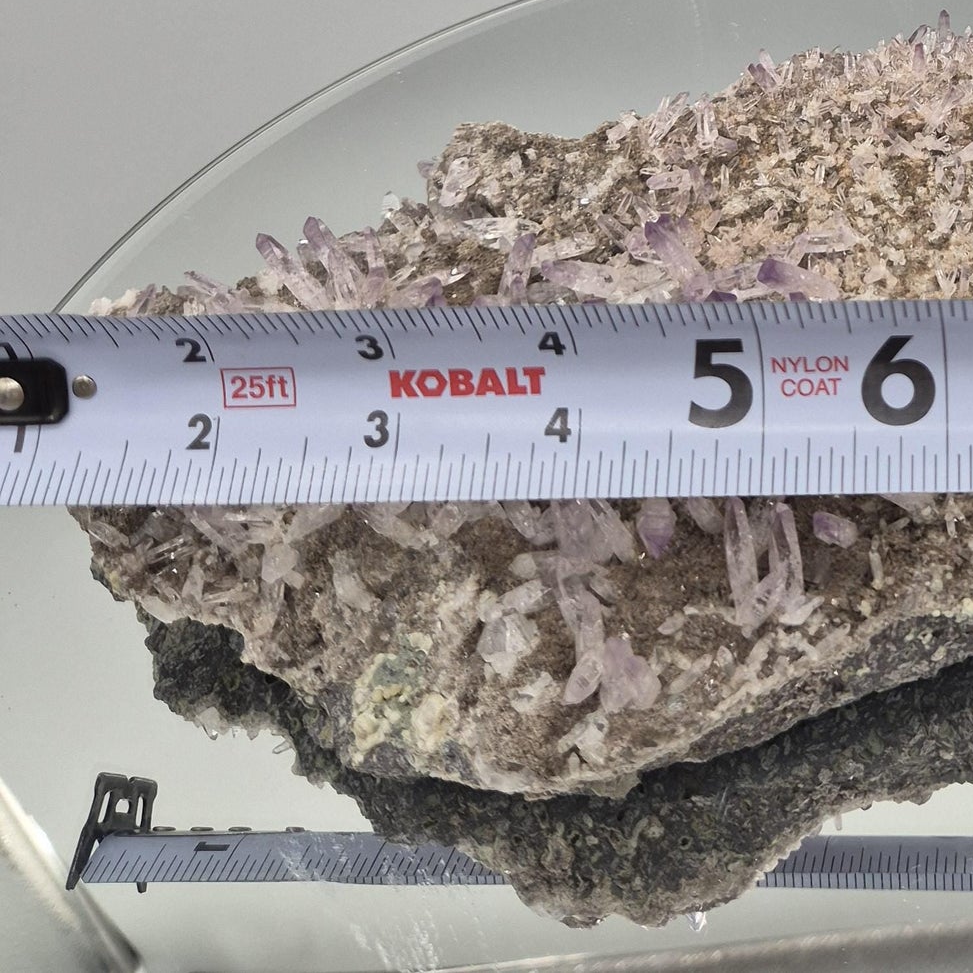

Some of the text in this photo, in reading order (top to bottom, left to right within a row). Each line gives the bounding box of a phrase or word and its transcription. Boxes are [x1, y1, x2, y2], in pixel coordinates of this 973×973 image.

[176, 338, 206, 362] 2
[355, 335, 383, 360] 3
[538, 332, 566, 355] 4
[772, 356, 849, 373] NYLON
[231, 375, 288, 399] 25ft
[389, 367, 545, 397] KOBALT
[688, 338, 753, 428] 5
[781, 378, 842, 397] COAT
[861, 335, 935, 425] 6
[186, 413, 211, 450] 2
[363, 410, 388, 448] 3
[545, 407, 572, 442] 4
